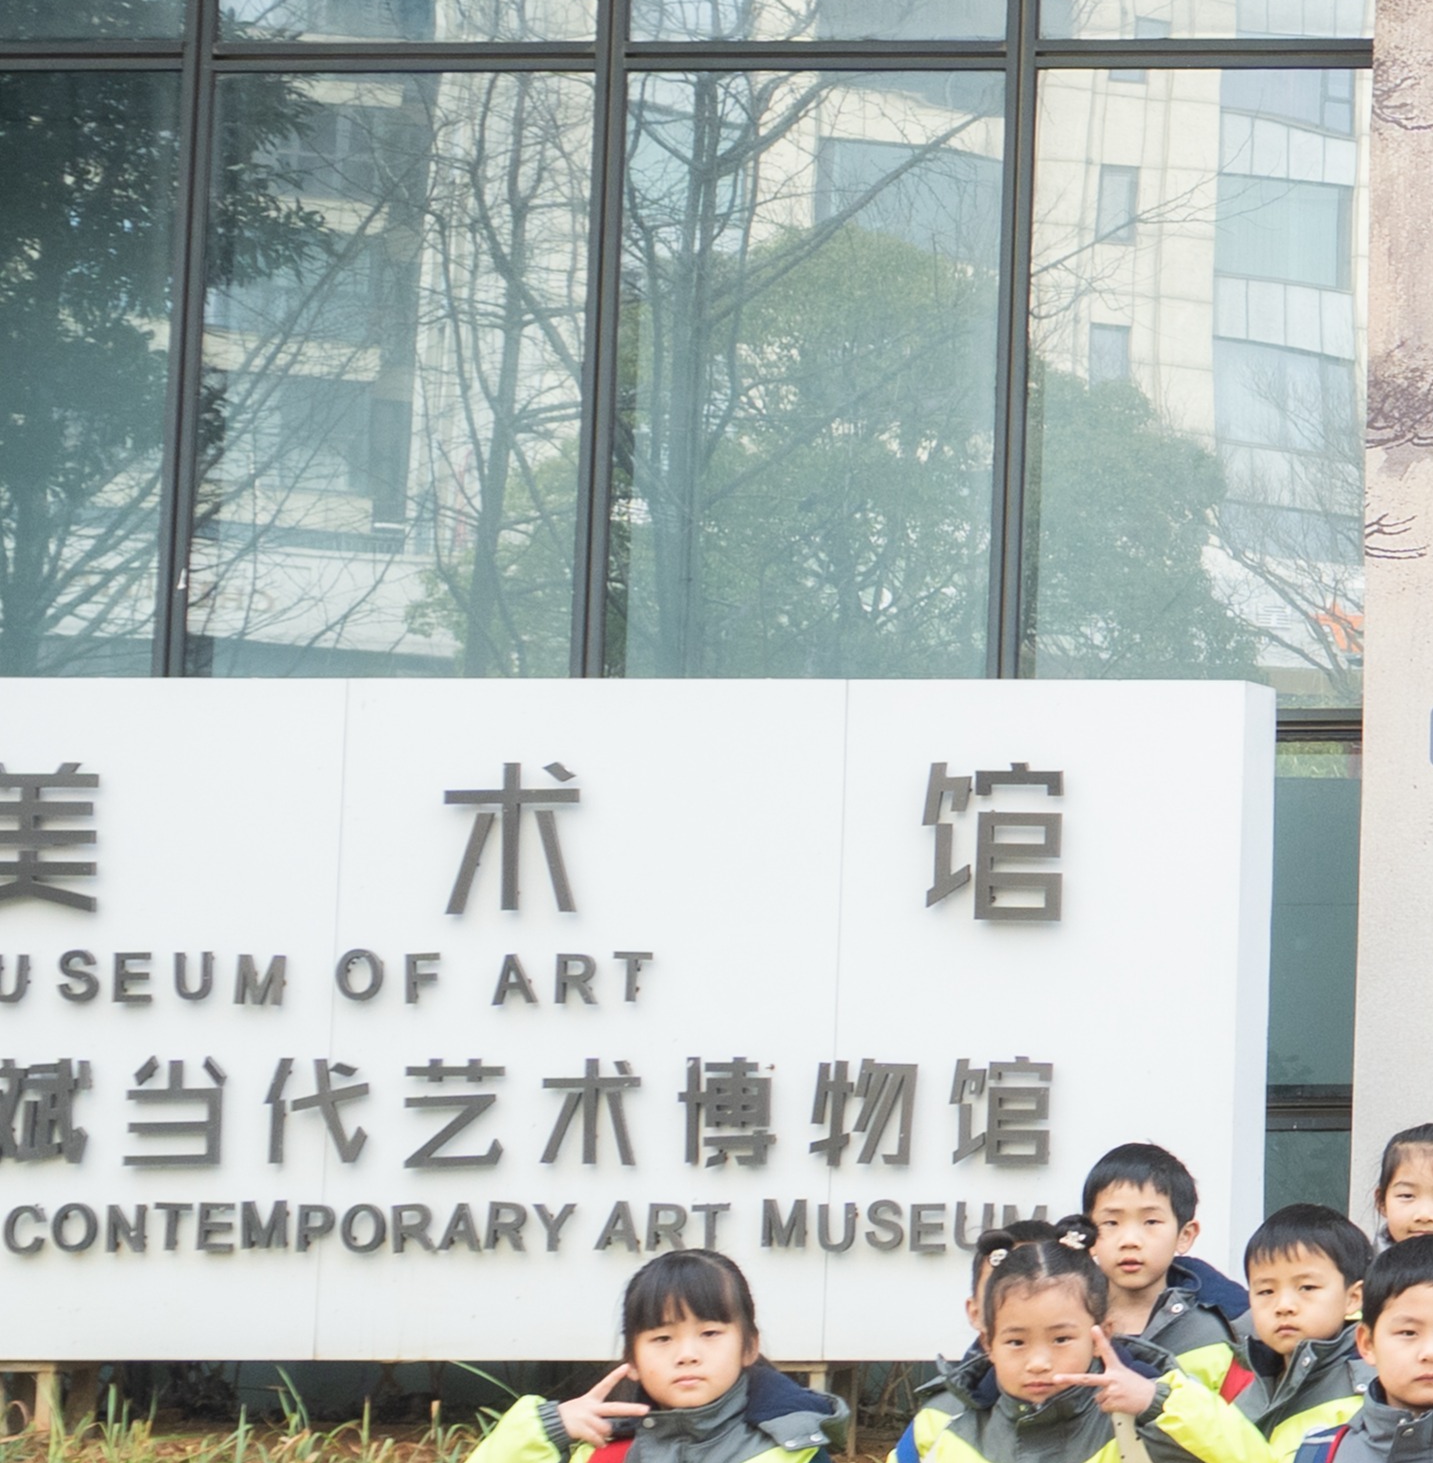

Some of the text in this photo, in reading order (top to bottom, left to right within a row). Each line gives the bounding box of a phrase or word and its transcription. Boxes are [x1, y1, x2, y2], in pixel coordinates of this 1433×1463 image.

[0, 762, 1062, 921] 美术馆
[336, 947, 442, 1006] OF
[491, 949, 654, 1006] ART
[3, 1199, 578, 1255] CONTEMPORARY
[594, 1200, 731, 1253] ART
